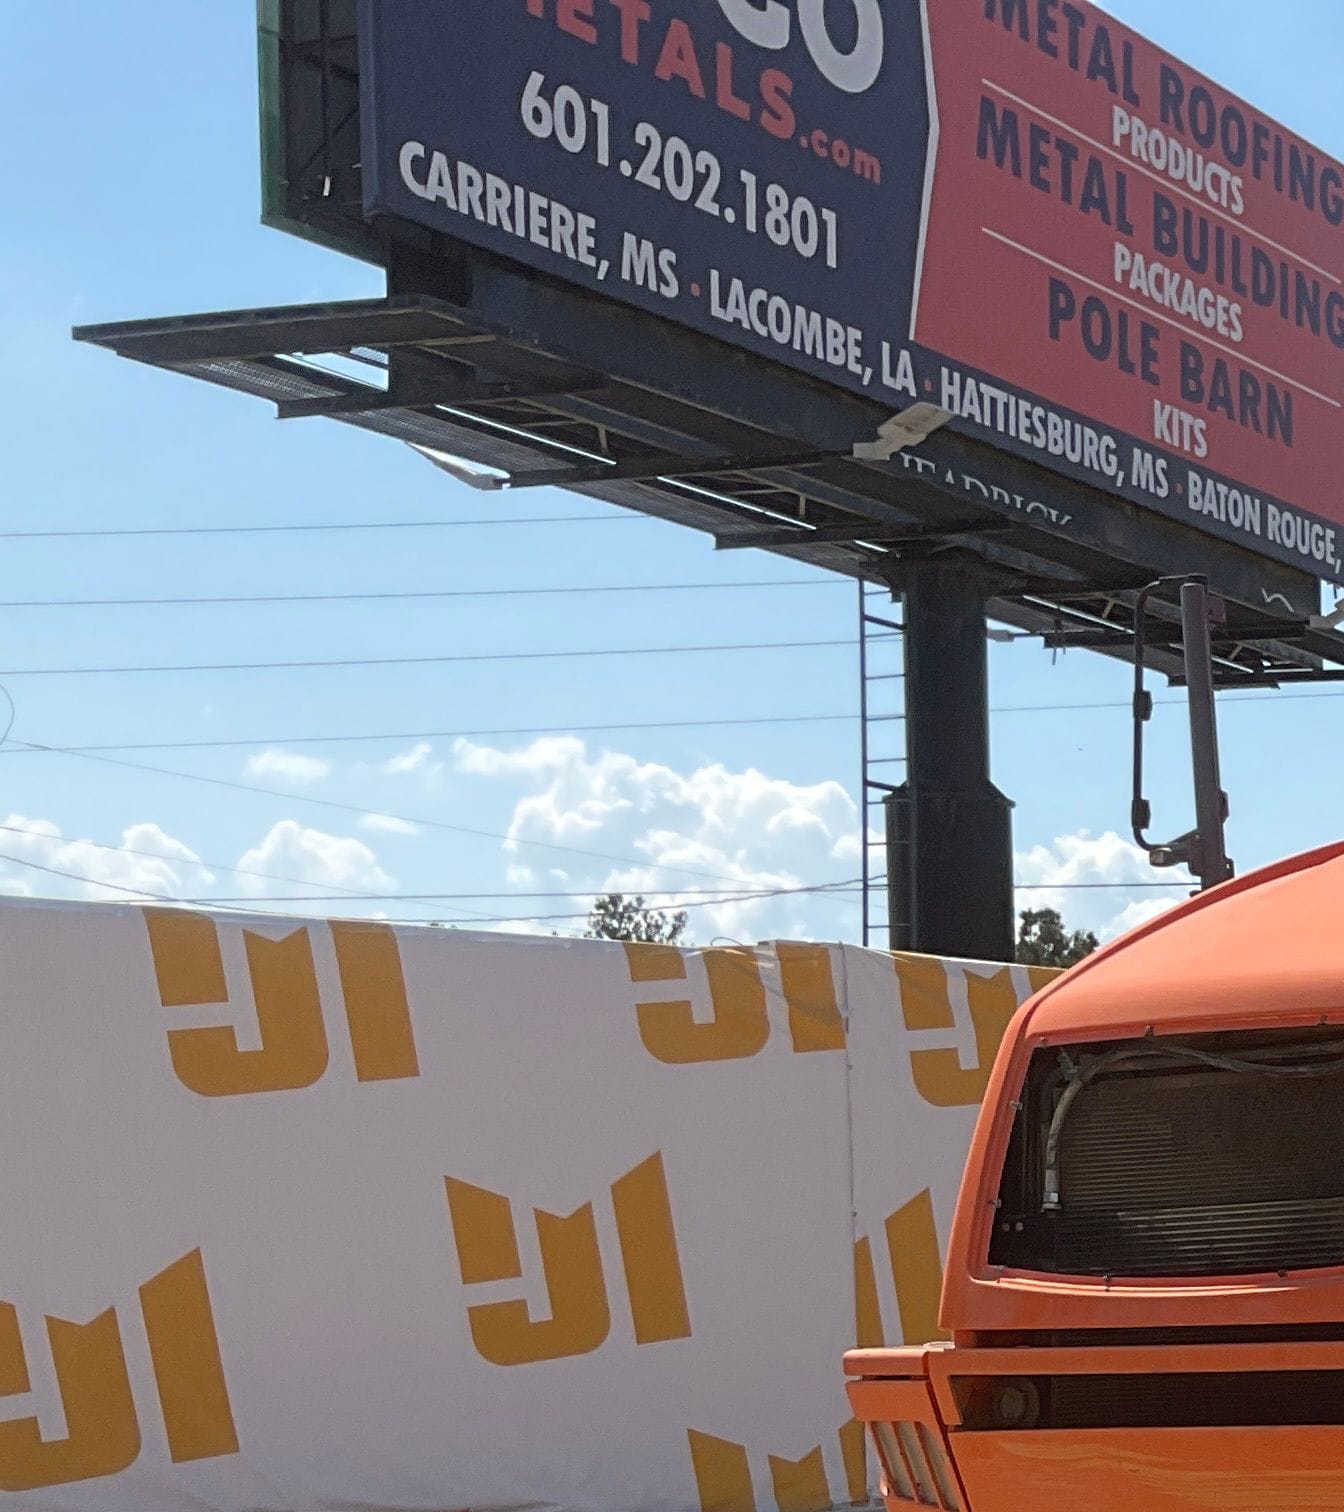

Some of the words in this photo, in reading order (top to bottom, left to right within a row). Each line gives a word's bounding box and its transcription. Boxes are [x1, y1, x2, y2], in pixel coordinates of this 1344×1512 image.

[521, 71, 838, 269] 601.202.1801
[976, 96, 1134, 237] METAL
[984, 0, 1140, 107] METAL
[1159, 62, 1344, 226] ROOFING
[1112, 105, 1245, 215] PRODUCTS
[399, 141, 611, 281] CARRIERE,
[621, 232, 679, 298] MS
[710, 269, 873, 386] LACOMBE,
[882, 339, 917, 397] LA
[941, 367, 1126, 487] HATTIESBURG,
[1132, 447, 1169, 498] MS
[1188, 471, 1264, 534] BATON
[1267, 503, 1342, 573] ROUGE,
[1048, 277, 1161, 386] POLE
[1180, 340, 1293, 448] BARN
[1114, 242, 1243, 342] PACKAGES
[1153, 400, 1208, 458] KITS
